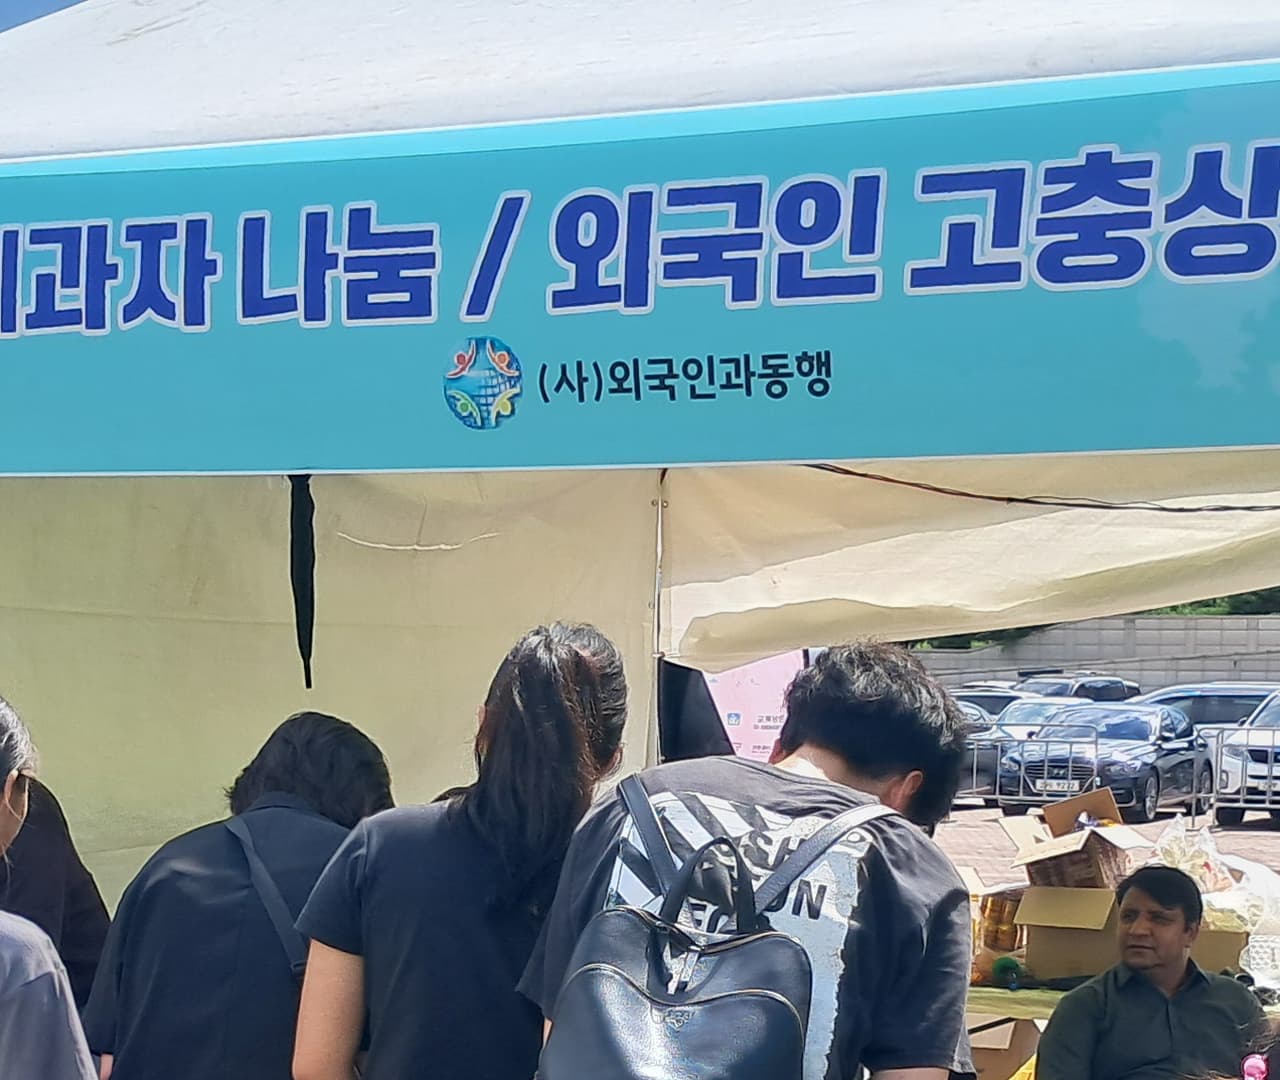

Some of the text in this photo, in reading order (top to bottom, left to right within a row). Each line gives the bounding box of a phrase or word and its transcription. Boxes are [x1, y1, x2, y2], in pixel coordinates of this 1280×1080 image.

[236, 202, 441, 327] 나눔
[461, 191, 530, 320] /
[546, 167, 886, 315] 외국인
[538, 350, 833, 403] (사)외국인과동행
